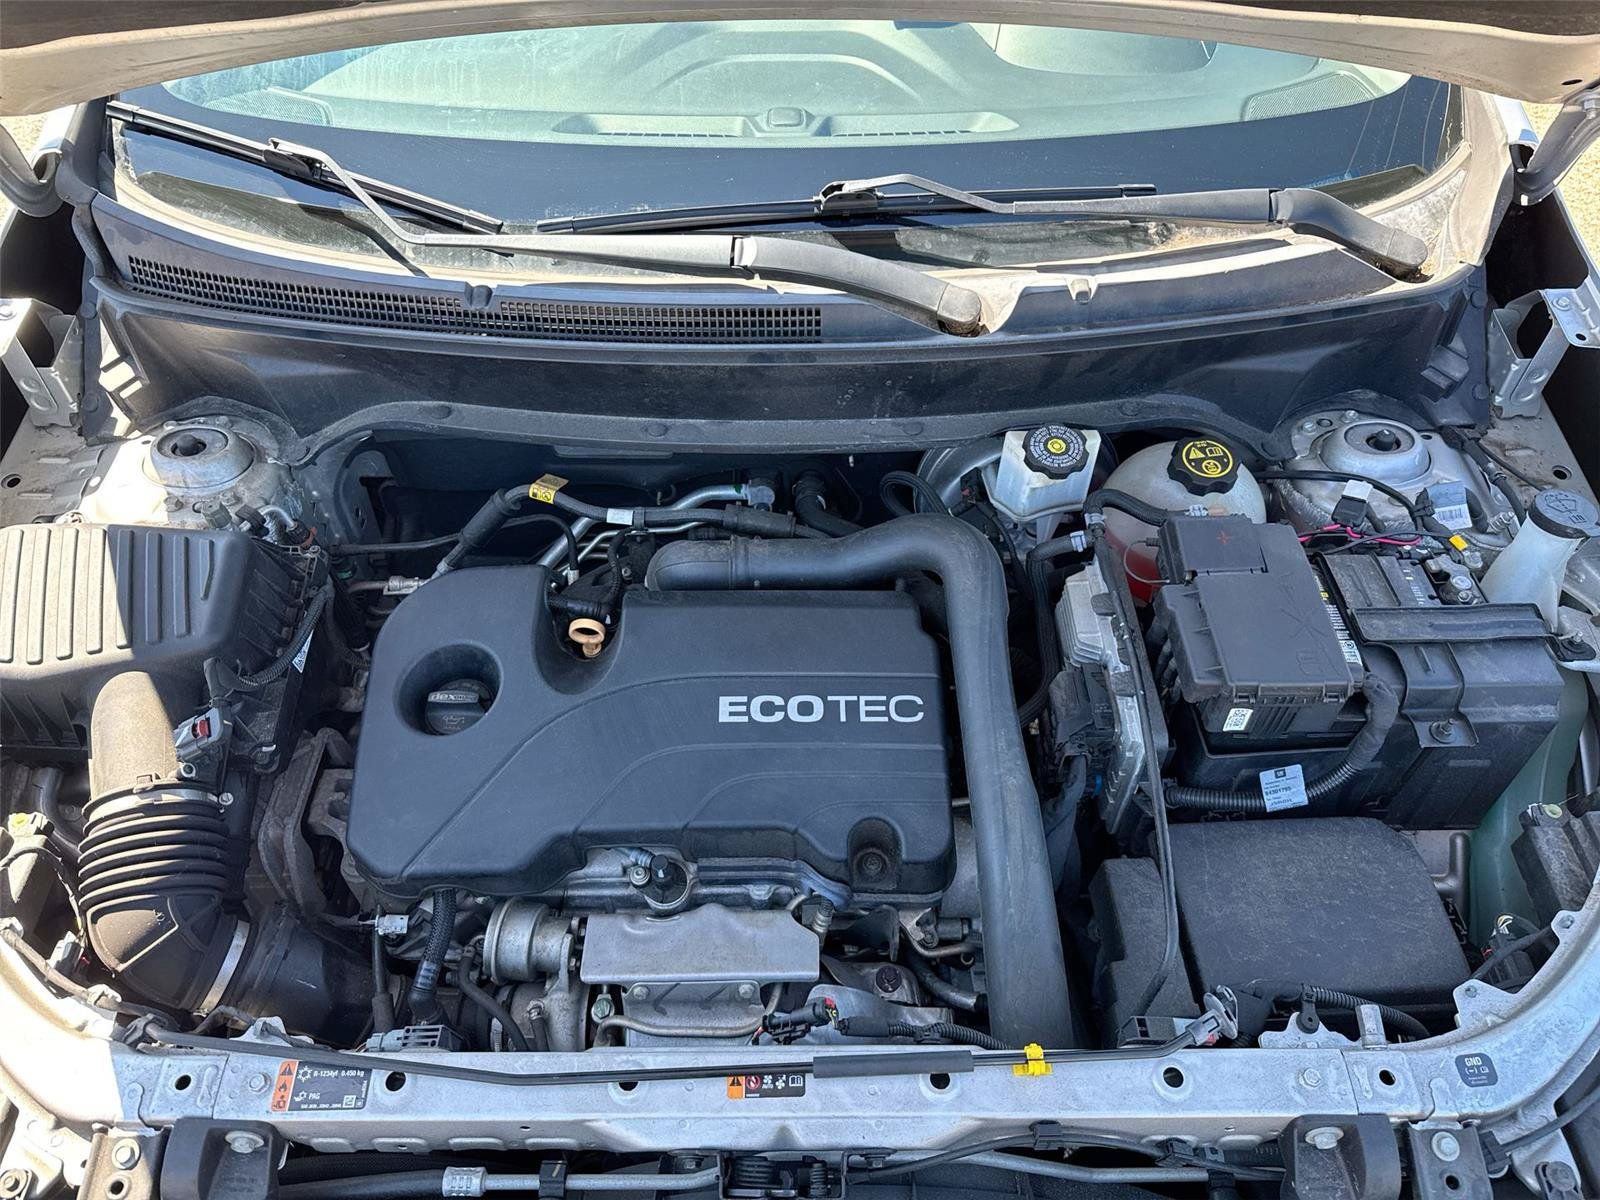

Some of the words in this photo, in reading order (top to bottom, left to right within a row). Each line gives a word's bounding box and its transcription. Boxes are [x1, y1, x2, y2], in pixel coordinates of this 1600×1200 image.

[718, 695, 924, 723] ECOTEC
[1464, 1056, 1482, 1067] GND
[356, 1069, 365, 1078] kg
